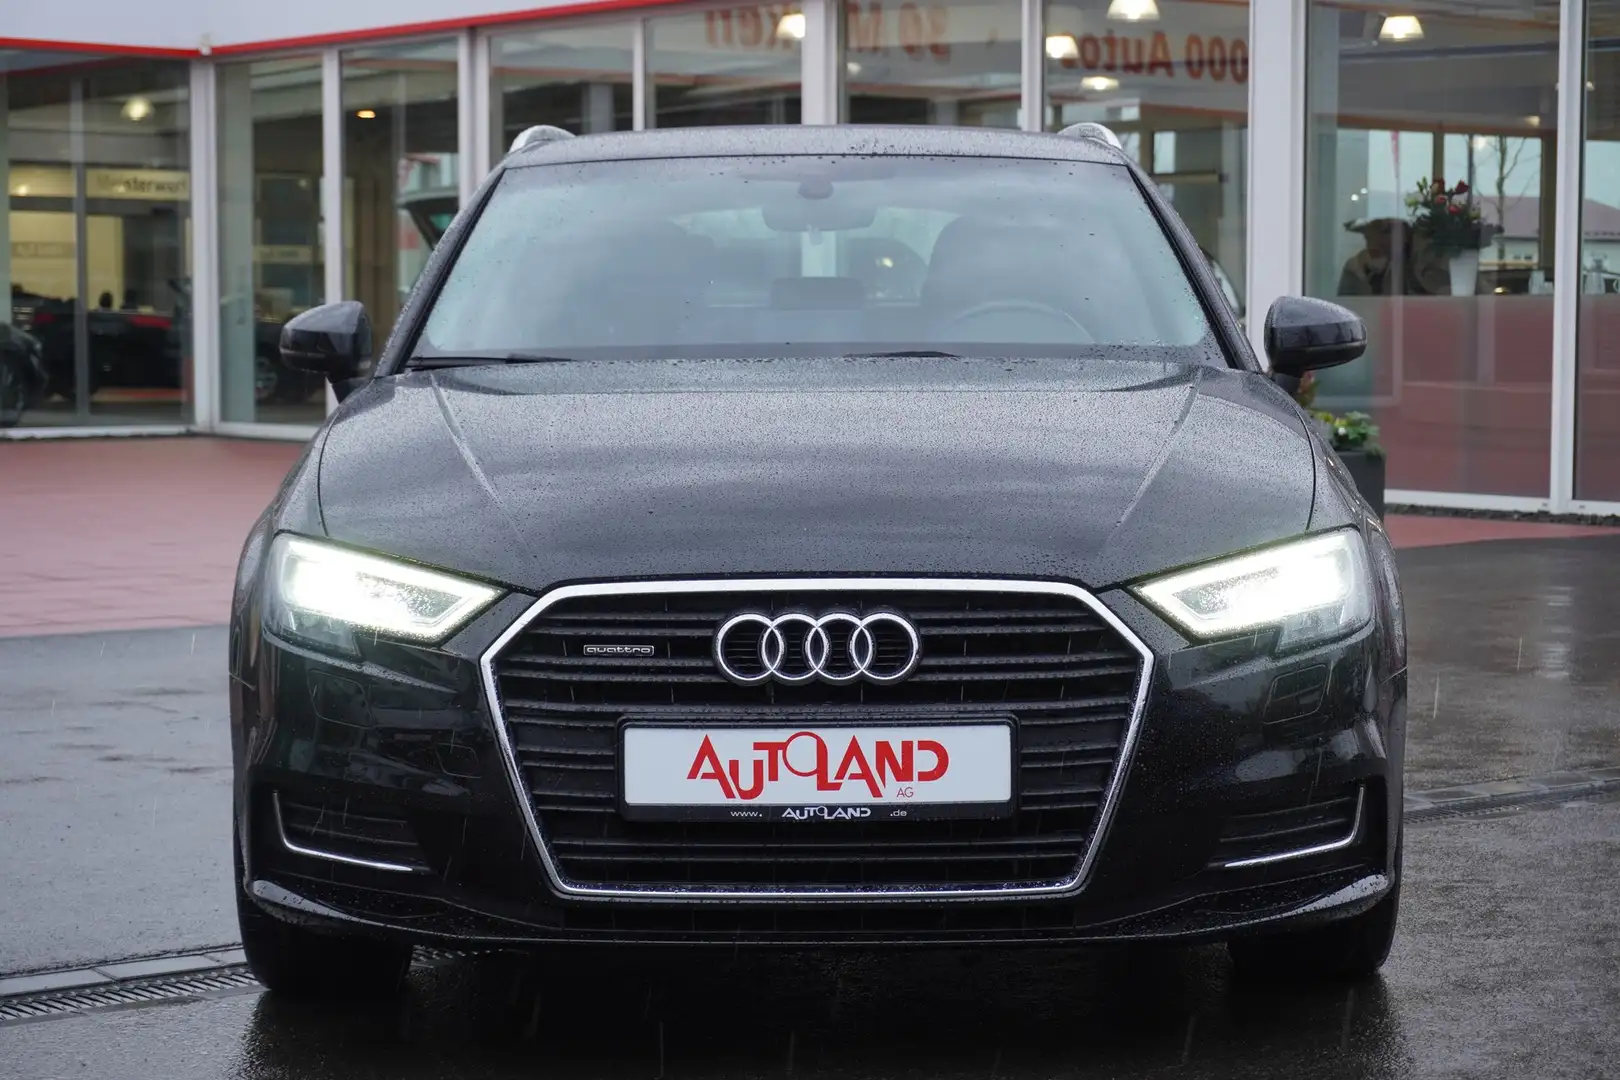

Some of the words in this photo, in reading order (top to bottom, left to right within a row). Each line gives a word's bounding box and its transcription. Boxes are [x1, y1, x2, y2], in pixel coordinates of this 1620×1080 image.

[586, 646, 651, 654] quattro
[687, 731, 949, 800] AUTOLAND
[896, 786, 914, 798] AG
[889, 809, 908, 817] .de
